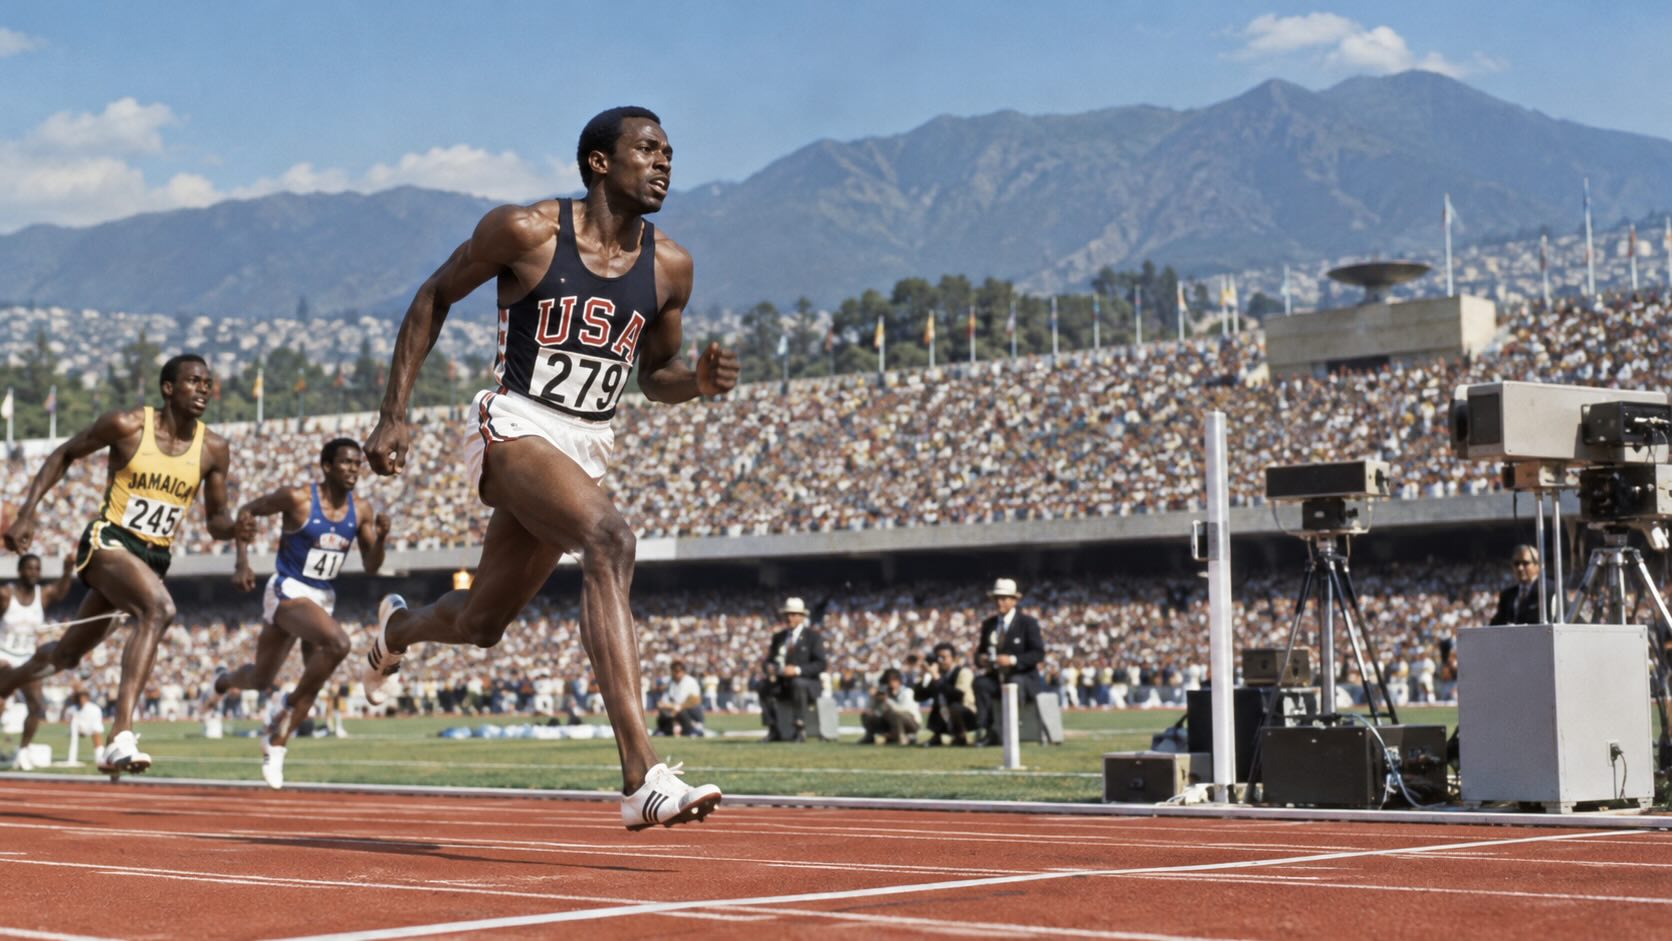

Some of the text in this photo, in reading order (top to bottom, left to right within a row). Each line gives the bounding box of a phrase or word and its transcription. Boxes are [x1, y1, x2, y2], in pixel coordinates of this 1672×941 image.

[535, 296, 646, 364] USA
[540, 352, 623, 410] 279
[128, 472, 193, 502] JAMAICA
[128, 499, 180, 535] 245
[313, 552, 338, 577] 41
